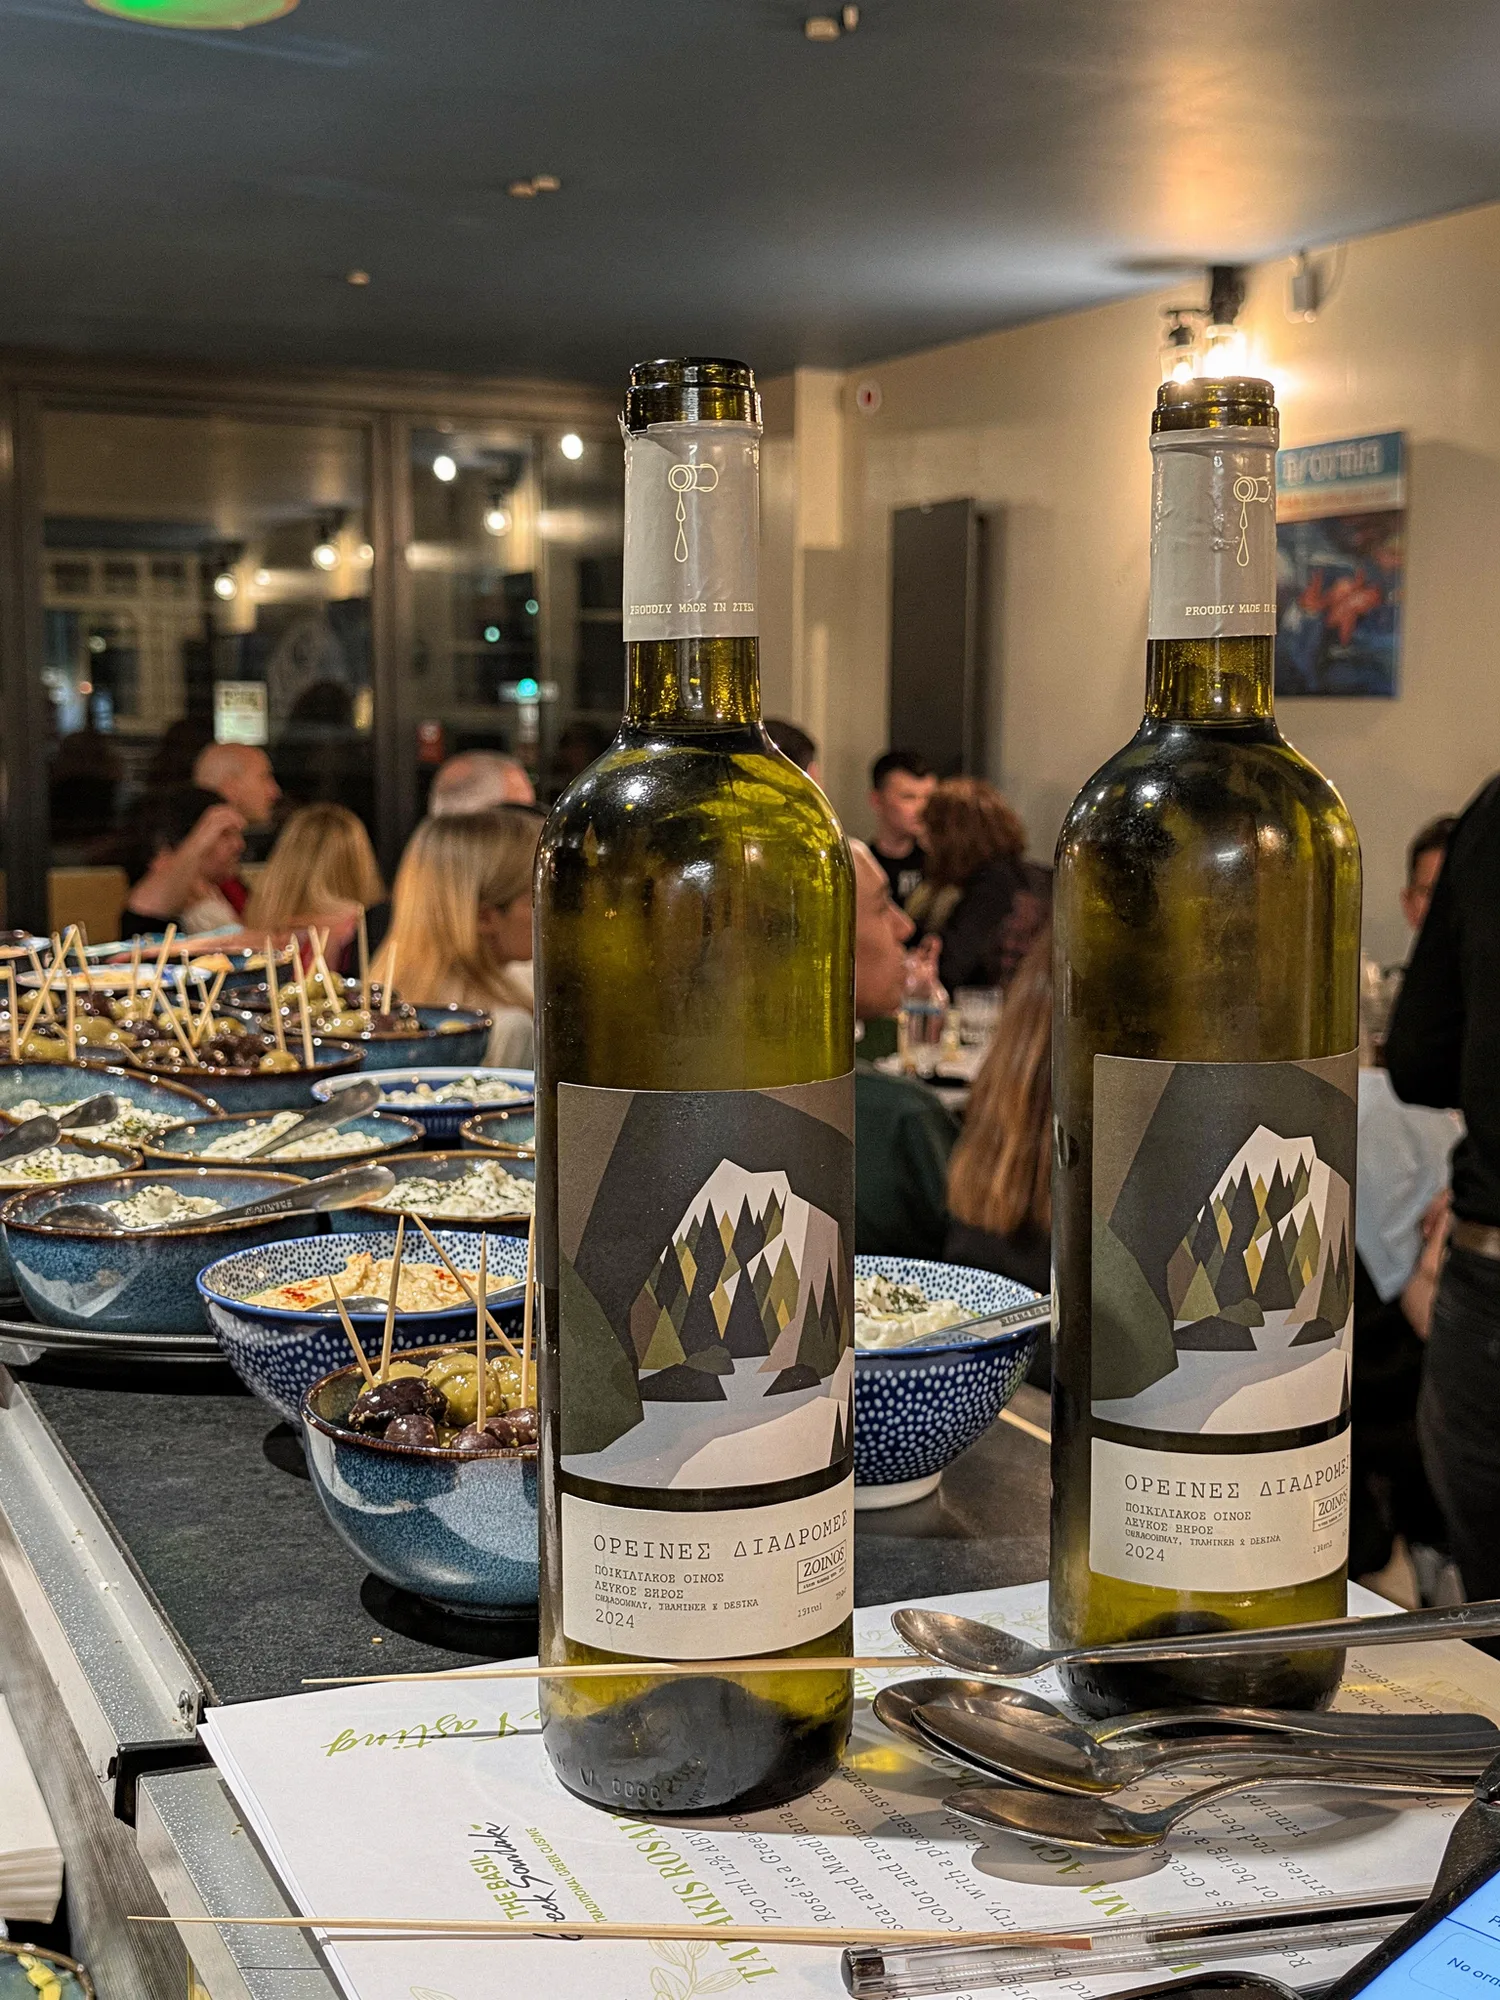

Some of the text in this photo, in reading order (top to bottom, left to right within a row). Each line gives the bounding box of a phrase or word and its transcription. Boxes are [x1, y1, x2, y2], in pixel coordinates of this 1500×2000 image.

[713, 602, 726, 611] IN
[1185, 604, 1234, 616] PROUDLY
[1125, 1474, 1240, 1499] ΟΡΕΙΝΕΣ
[1125, 1516, 1168, 1532] ΛΕΥΚΟΣ
[1213, 1511, 1251, 1521] ΟΙΝΟΣ
[593, 1509, 848, 1560] ΟΡΕΙΝΕΣ ΔΙΑΔΡΟΜΕΣ
[803, 1547, 845, 1577] ZOINOS
[1125, 1542, 1165, 1562] 2024
[594, 1580, 637, 1596] ΛΕΥΚΟΣ
[683, 1573, 724, 1583] ΟΙΝΟΣ
[595, 1608, 635, 1629] 2024
[320, 1711, 519, 1757] Tasting
[681, 1830, 719, 1852] ABV
[736, 1830, 782, 1864] Greek
[1190, 1836, 1211, 1846] a
[705, 1854, 740, 1877] 12%
[775, 1864, 793, 1874] a
[816, 1805, 955, 1923] color and aromas of
[937, 1859, 954, 1867] a
[1151, 1849, 1208, 1887] Greek
[1204, 1849, 1257, 1882] being
[468, 1854, 530, 1920] THE BASIL
[725, 1877, 758, 1897] ml
[782, 1875, 805, 1888] is
[834, 1876, 873, 1901] and
[942, 1869, 985, 1899] with
[1202, 1889, 1221, 1897] a
[747, 1898, 783, 1922] 750
[790, 1889, 836, 1922] Rosé
[1447, 1957, 1471, 1972] No
